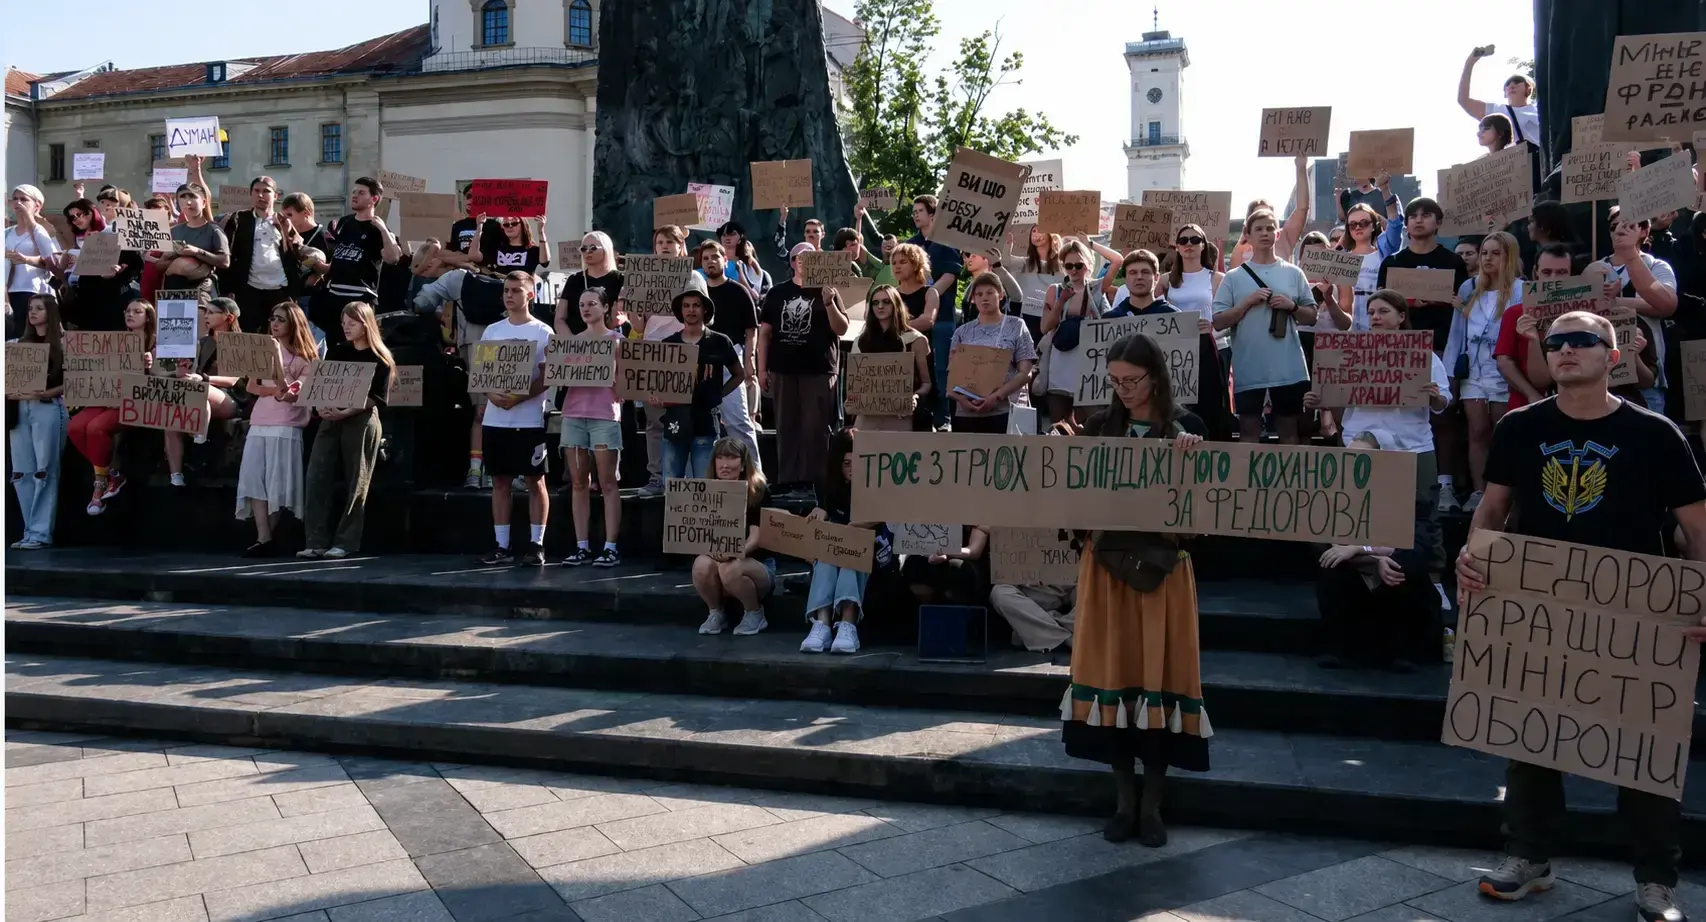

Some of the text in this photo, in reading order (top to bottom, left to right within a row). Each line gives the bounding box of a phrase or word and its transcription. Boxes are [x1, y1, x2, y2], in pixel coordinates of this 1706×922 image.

[957, 171, 1007, 199] ВИ ЩО
[1156, 317, 1181, 335] ЗА
[621, 341, 687, 364] ВЕРНІТЬ
[546, 364, 610, 381] ЗАГИНЕМО
[123, 399, 139, 422] В
[859, 451, 922, 488] ТРОЄ
[929, 450, 944, 485] З
[1041, 446, 1058, 489] В
[1181, 450, 1231, 485] МОГО
[1248, 450, 1372, 490] КОХАНОГО
[669, 480, 707, 493] НІХТО
[1164, 487, 1372, 539] ЗА ФЕДОРОВА
[1471, 536, 1706, 616] ФЕДОРОВ
[1451, 691, 1681, 788] ОБОРОНИ
